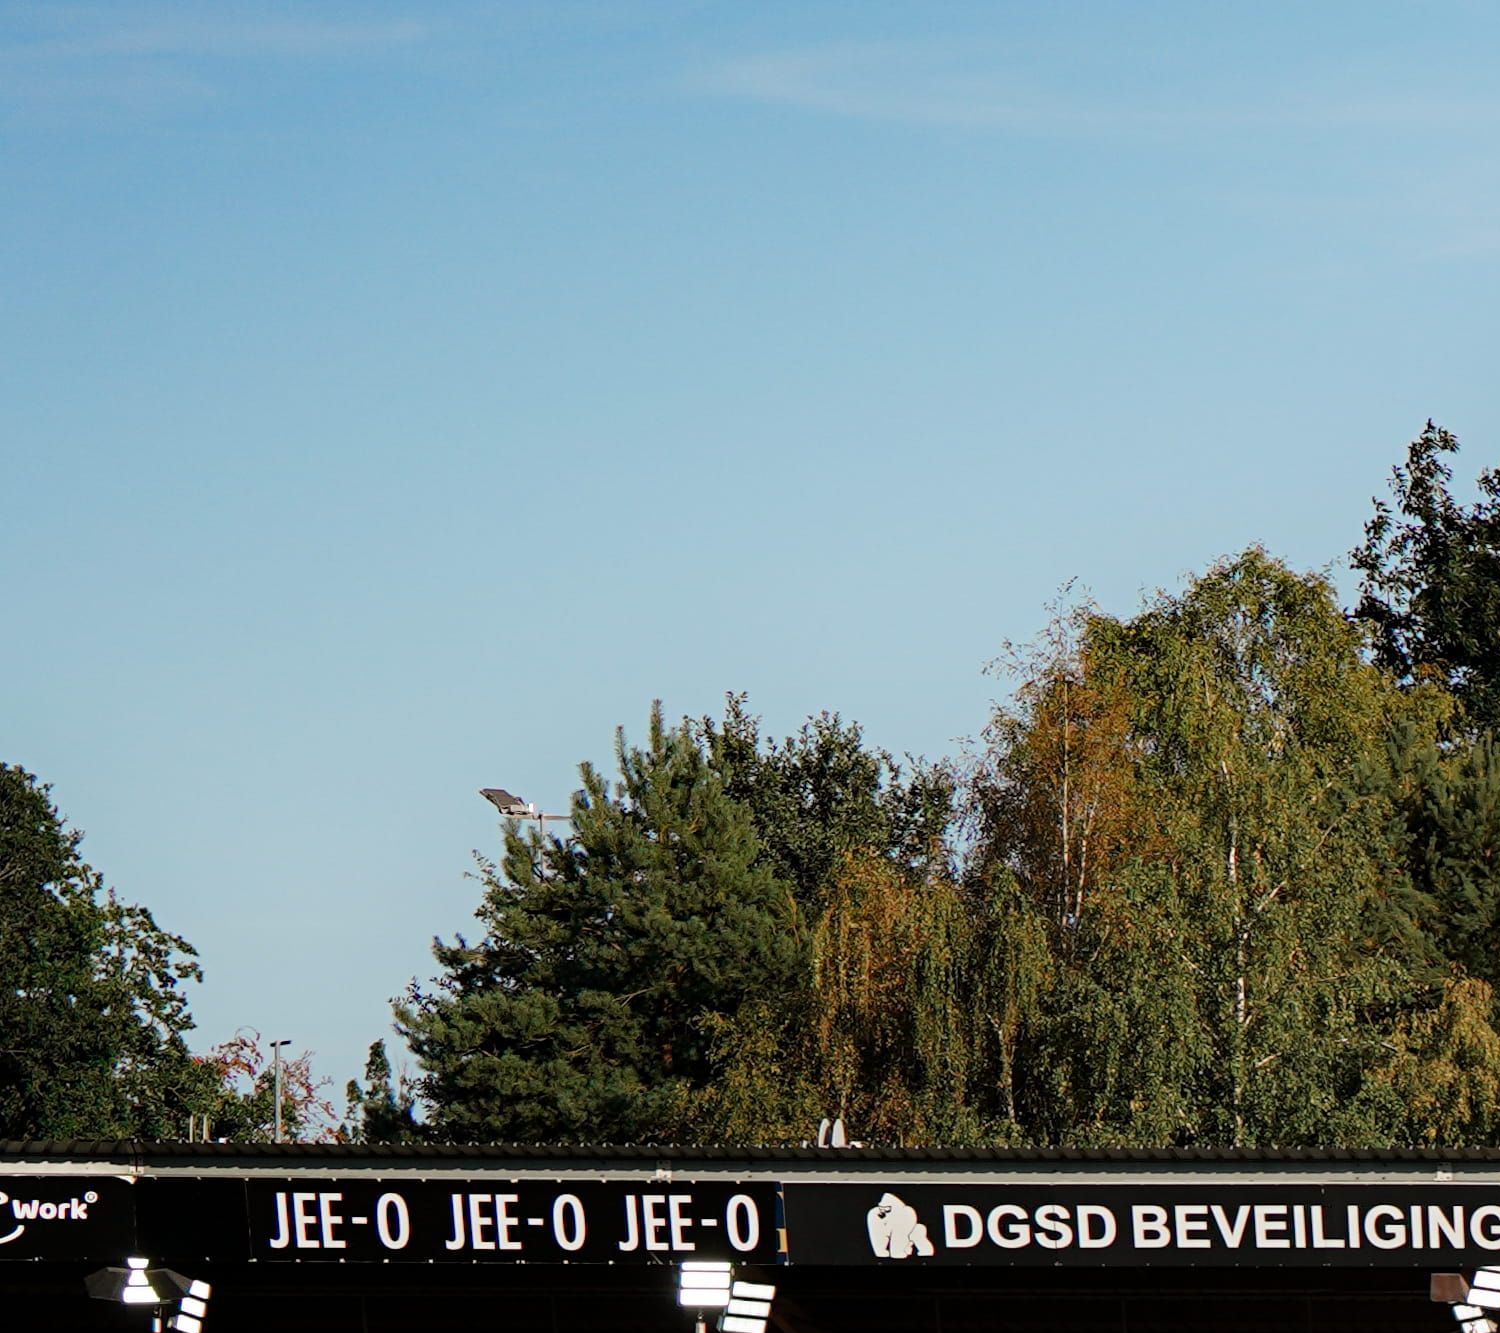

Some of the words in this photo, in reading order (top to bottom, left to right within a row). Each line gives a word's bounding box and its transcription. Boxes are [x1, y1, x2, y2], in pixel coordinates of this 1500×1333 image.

[270, 1192, 409, 1249] JEE-O
[446, 1194, 585, 1250] JEE-O
[619, 1195, 759, 1251] JEE-O
[943, 1205, 1116, 1249] DGSD
